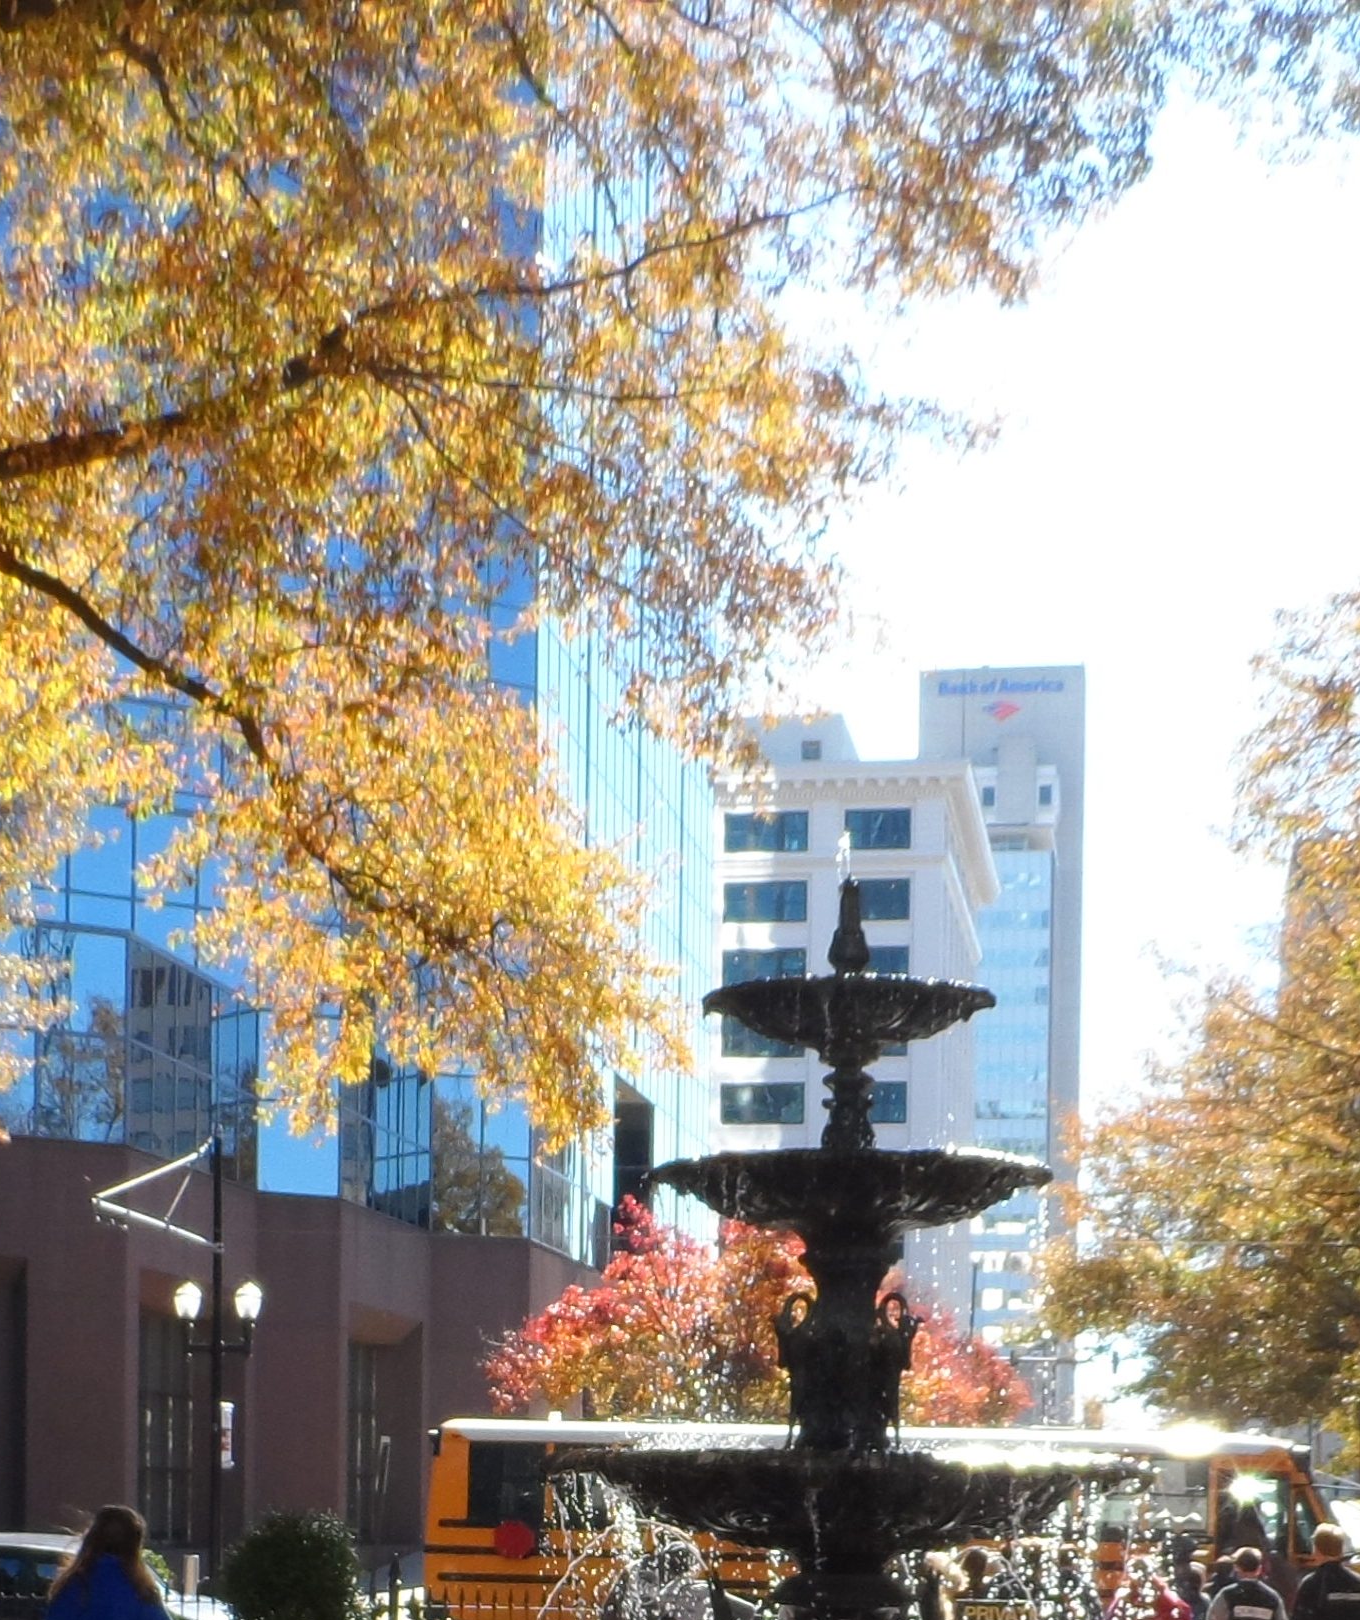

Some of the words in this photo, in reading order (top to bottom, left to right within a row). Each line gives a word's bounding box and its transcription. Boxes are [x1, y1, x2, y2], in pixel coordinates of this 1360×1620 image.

[939, 680, 978, 695] Bank
[981, 678, 996, 693] of
[998, 678, 1063, 692] America
